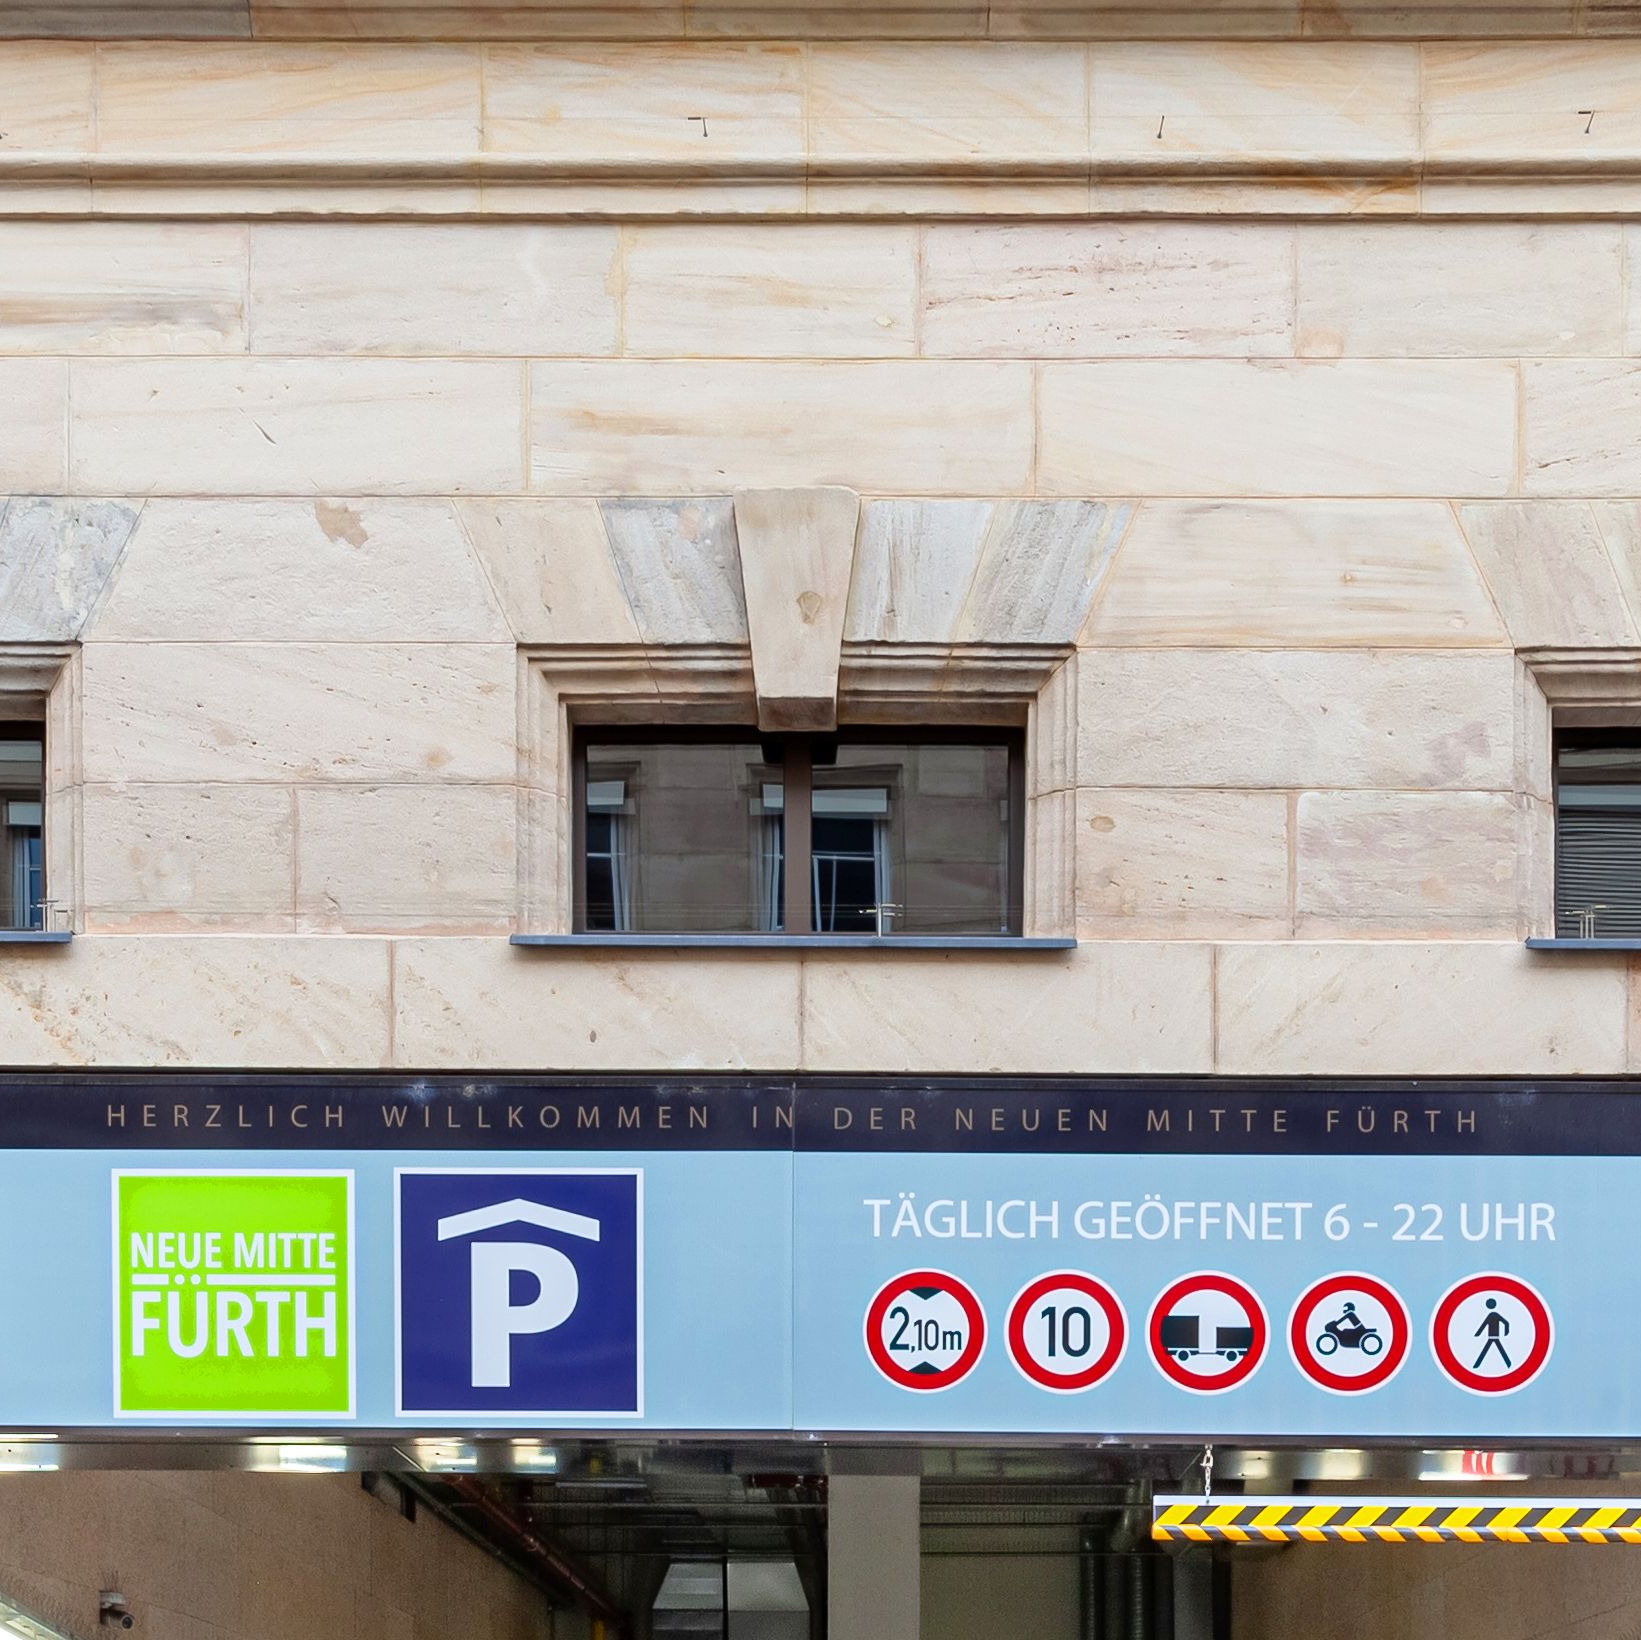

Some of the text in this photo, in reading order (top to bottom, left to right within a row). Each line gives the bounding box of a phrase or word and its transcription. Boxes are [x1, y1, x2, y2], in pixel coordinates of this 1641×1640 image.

[107, 1104, 1478, 1134] HERZLICH WILLKOMMEN IN DER NEUEN MITTE FÜRTH
[863, 1192, 1059, 1240] TÄGLICH
[1073, 1193, 1313, 1241] GEÖFFNET
[1323, 1203, 1351, 1241] 6
[1391, 1203, 1444, 1241] 22
[1459, 1202, 1556, 1241] UHR
[130, 1232, 336, 1269] NEUE MITTE
[131, 1273, 337, 1359] FÜRTH
[470, 1241, 579, 1388] P
[1041, 1306, 1091, 1358] 10
